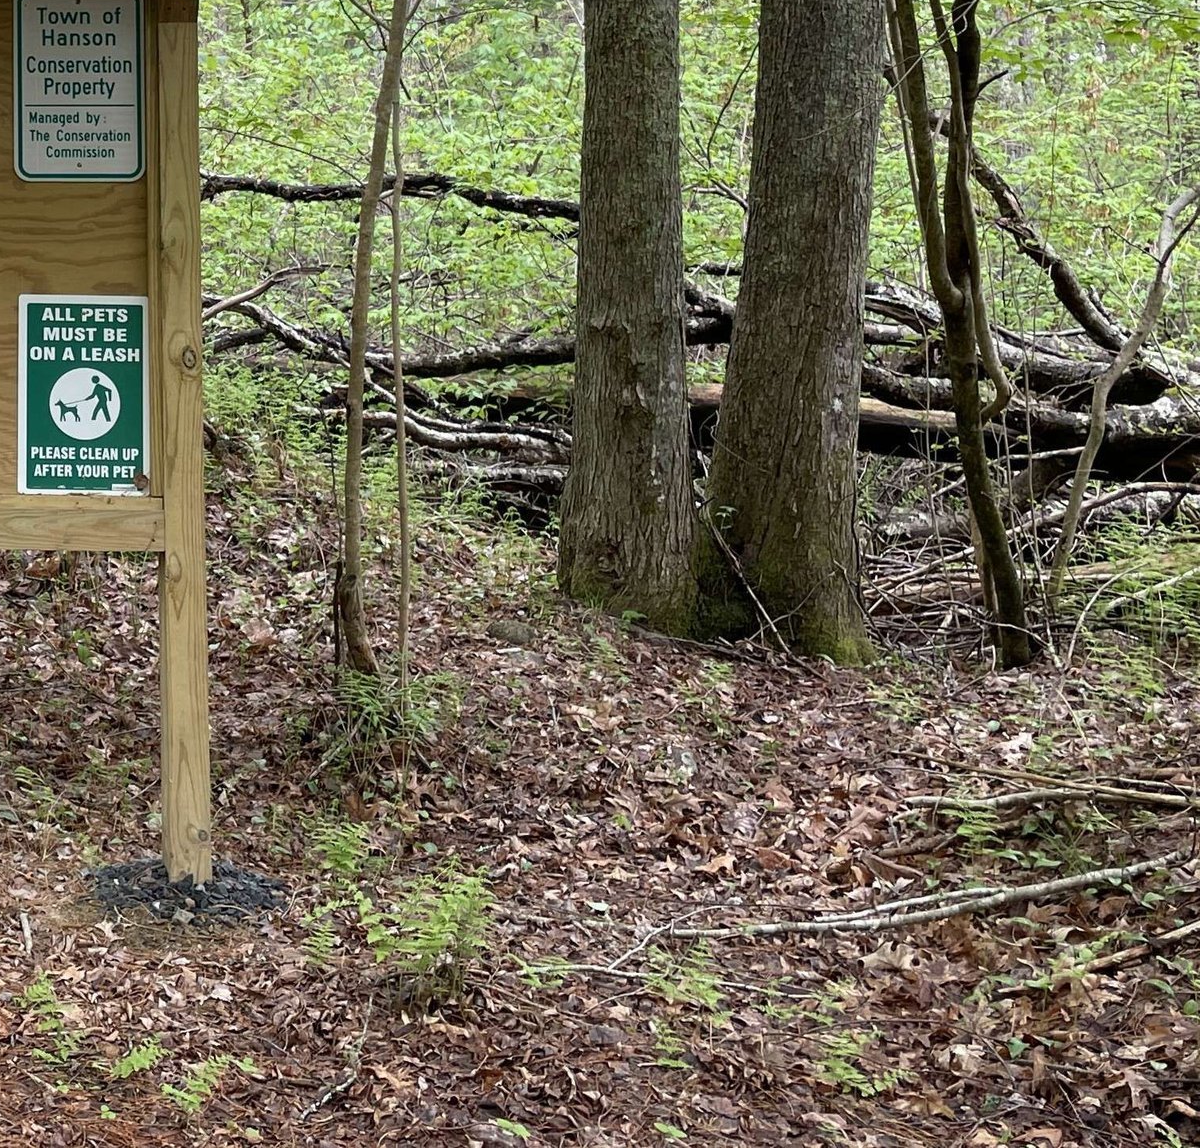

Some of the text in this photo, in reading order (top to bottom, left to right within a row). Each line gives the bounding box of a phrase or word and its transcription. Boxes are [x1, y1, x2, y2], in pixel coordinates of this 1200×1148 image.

[37, 7, 122, 24] Town of
[42, 29, 116, 46] Hanson
[27, 56, 132, 73] Conservation
[44, 78, 115, 99] Property
[29, 112, 79, 127] Managed
[30, 130, 130, 141] The Conservation
[46, 146, 114, 158] Commission
[42, 308, 128, 322] ALL PETS
[44, 327, 127, 342] MUST BE
[30, 347, 139, 362] ON A LEASH
[31, 447, 138, 460] PLEASE CLEAN UP
[34, 464, 136, 478] AFTER YOUR PET
